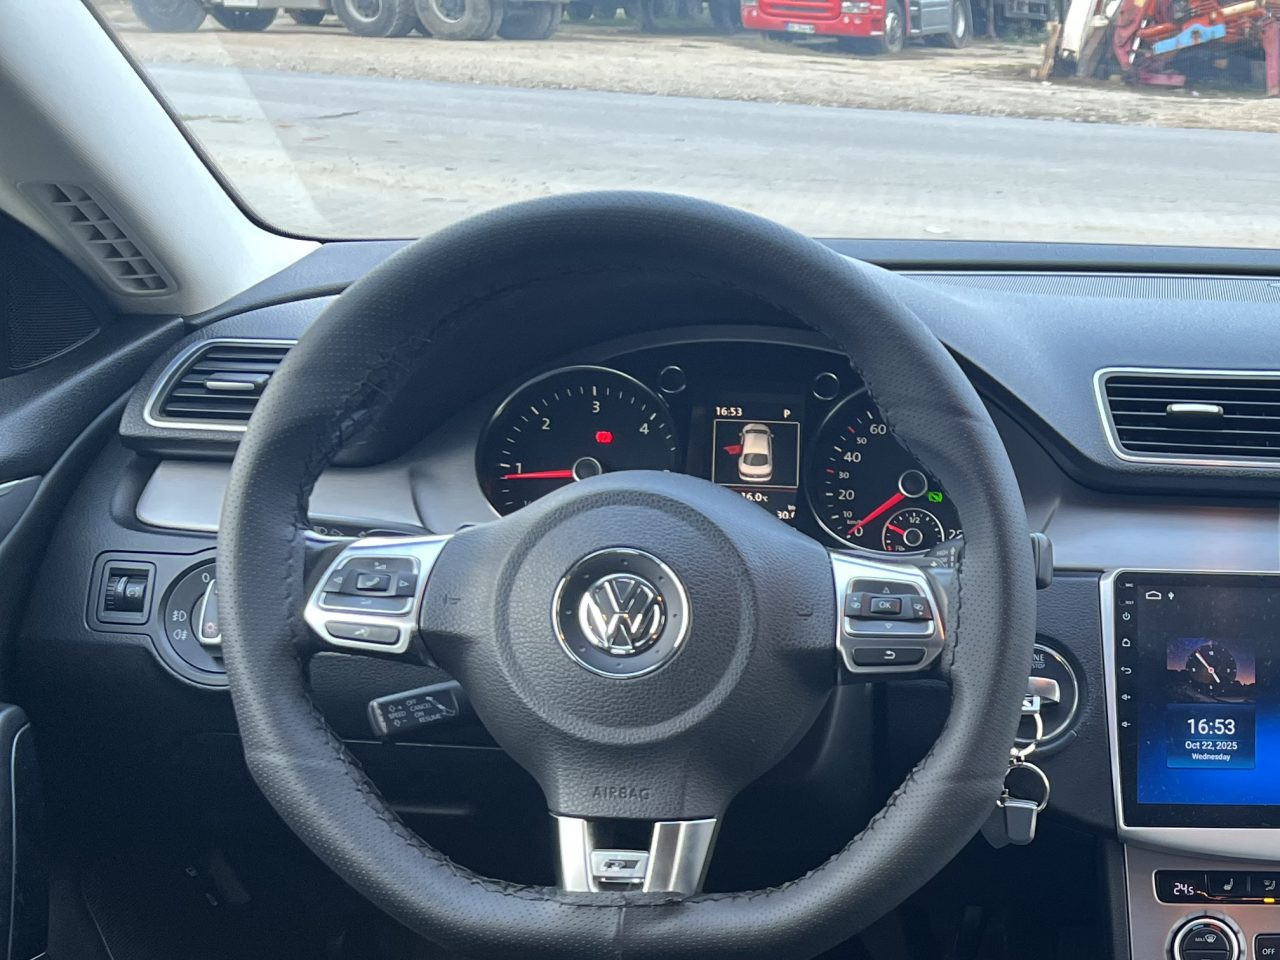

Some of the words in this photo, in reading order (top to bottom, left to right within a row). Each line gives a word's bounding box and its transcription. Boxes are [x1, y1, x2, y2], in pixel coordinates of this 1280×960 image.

[592, 401, 600, 413] 3
[716, 407, 742, 416] 16:53
[784, 409, 791, 418] P
[542, 418, 550, 430] 2
[639, 423, 650, 434] 4
[869, 424, 887, 435] 60
[843, 452, 861, 462] 40
[515, 463, 522, 474] 1
[838, 490, 855, 500] 20
[854, 526, 863, 537] 0
[1187, 718, 1235, 735] 16:53
[1185, 741, 1200, 750] Oct
[1201, 741, 1215, 751] 22,
[1216, 741, 1238, 750] 2025
[1192, 753, 1231, 762] Wednesday
[592, 785, 650, 800] AIRBAG
